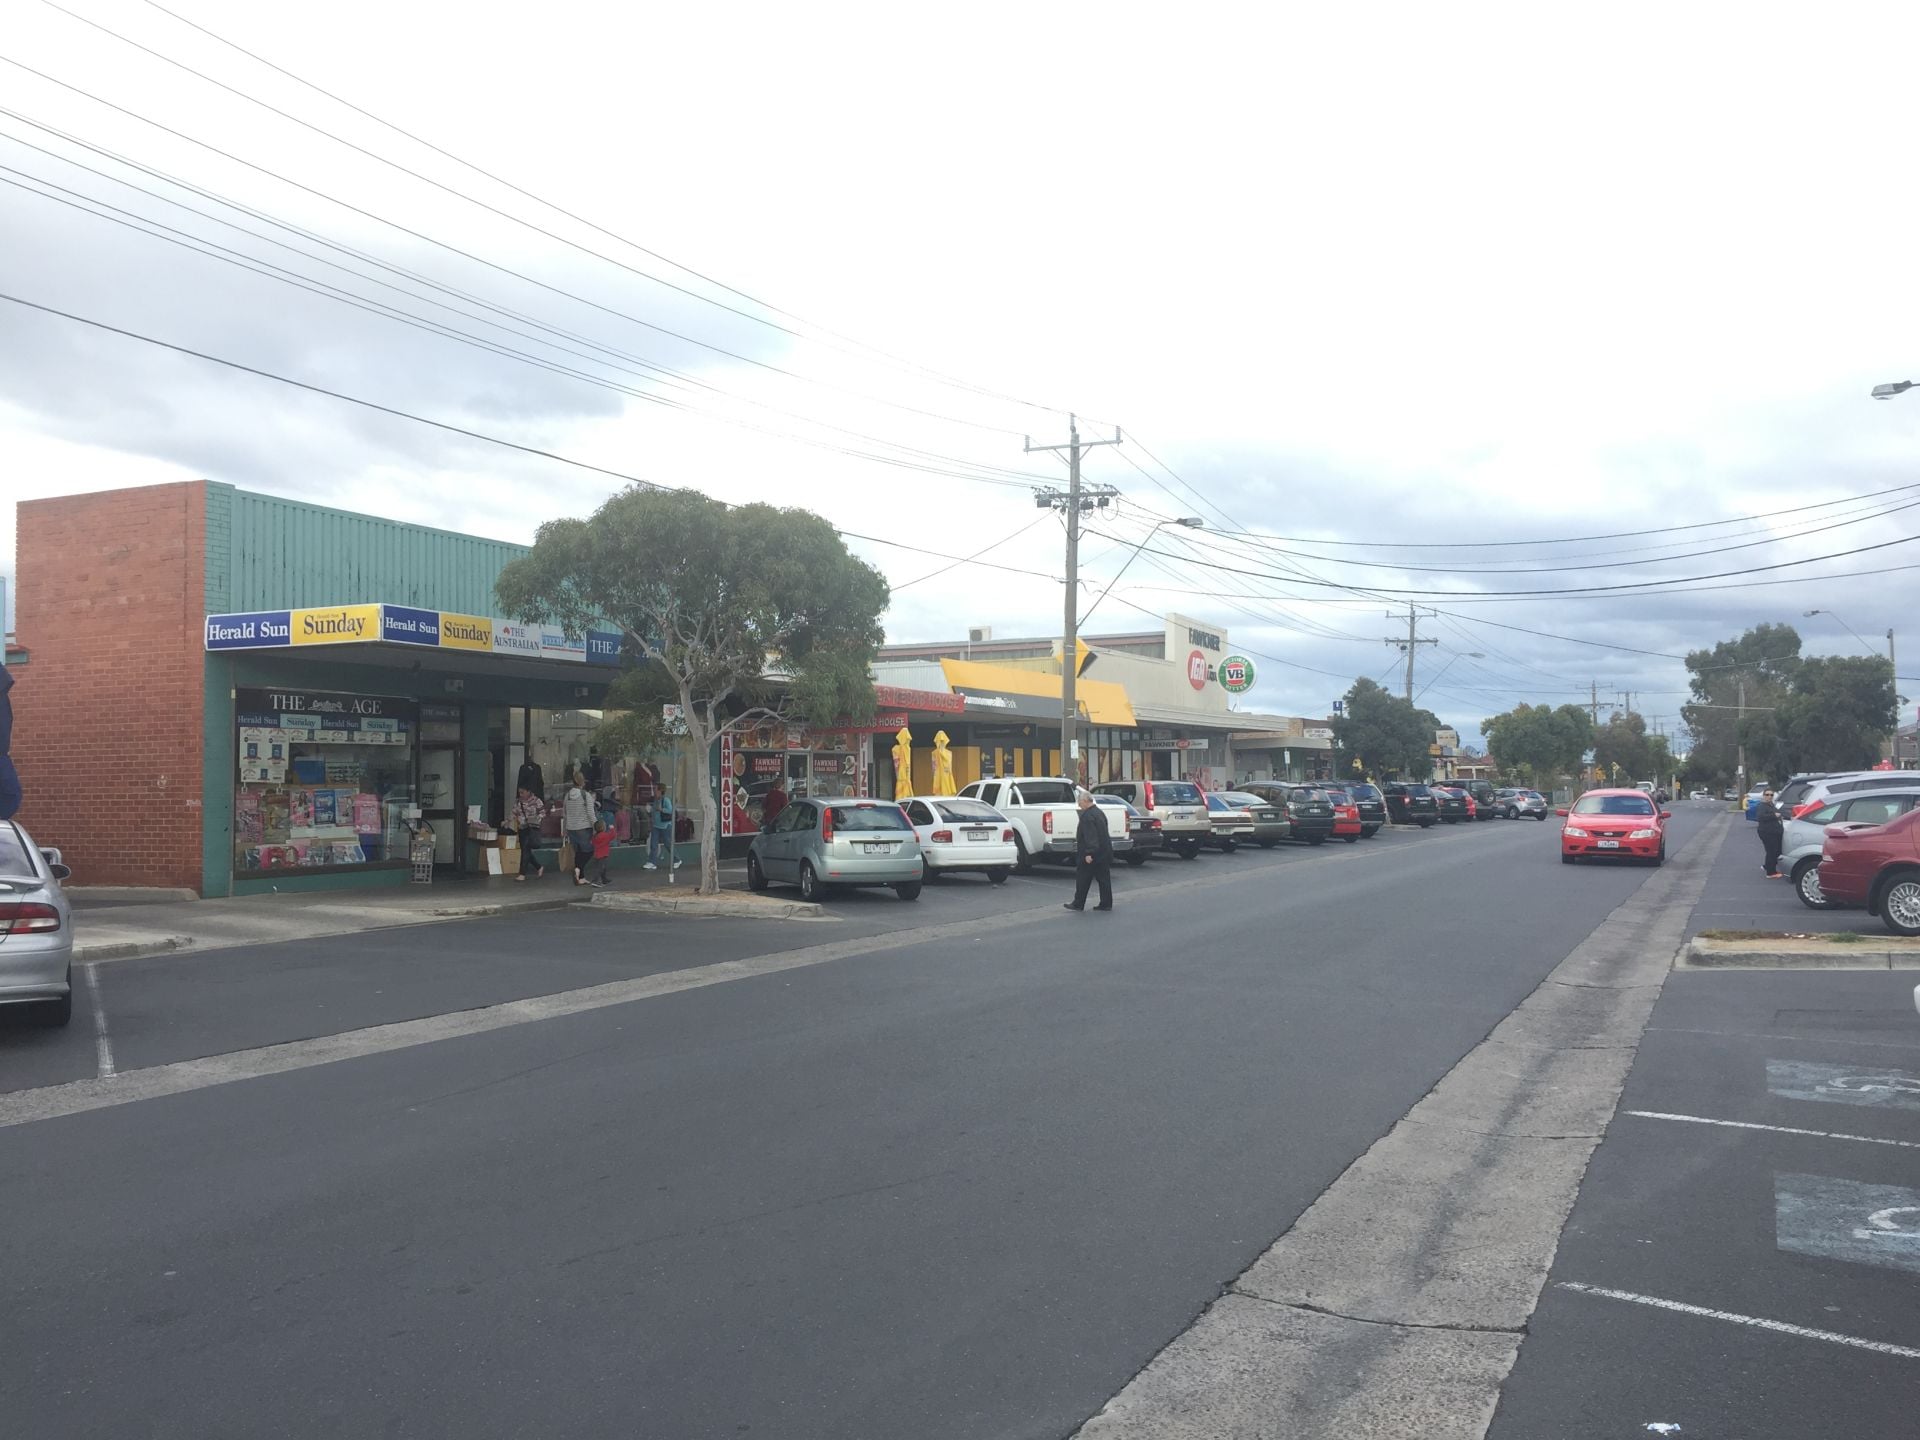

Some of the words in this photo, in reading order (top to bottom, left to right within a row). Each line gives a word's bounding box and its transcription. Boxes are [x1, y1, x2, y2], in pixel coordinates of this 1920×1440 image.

[303, 612, 366, 637] Sunday
[385, 616, 416, 632] Herald
[419, 621, 437, 635] Sun
[208, 622, 255, 641] Herald
[260, 621, 289, 638] Sun
[443, 621, 490, 645] Sunday
[510, 626, 525, 638] THE
[494, 635, 540, 651] AUSTRALIAN
[1188, 627, 1220, 652] FAWKNER
[589, 640, 614, 655] THE
[1227, 669, 1244, 679] VB
[269, 693, 305, 711] THE
[350, 699, 382, 715] AGE
[893, 688, 925, 707] KEBAB
[928, 692, 960, 709] HOUSE
[237, 715, 262, 724] Herald
[263, 716, 278, 725] Sun
[286, 717, 316, 728] Sunday
[322, 719, 346, 728] Herald
[347, 719, 359, 729] Sun
[366, 721, 394, 730] Sunday
[851, 718, 877, 728] KEBAB
[879, 717, 906, 727] HOUSE
[1143, 740, 1175, 748] FAWKNER
[755, 758, 781, 766] FAWKNER
[814, 759, 838, 767] FAWKNER
